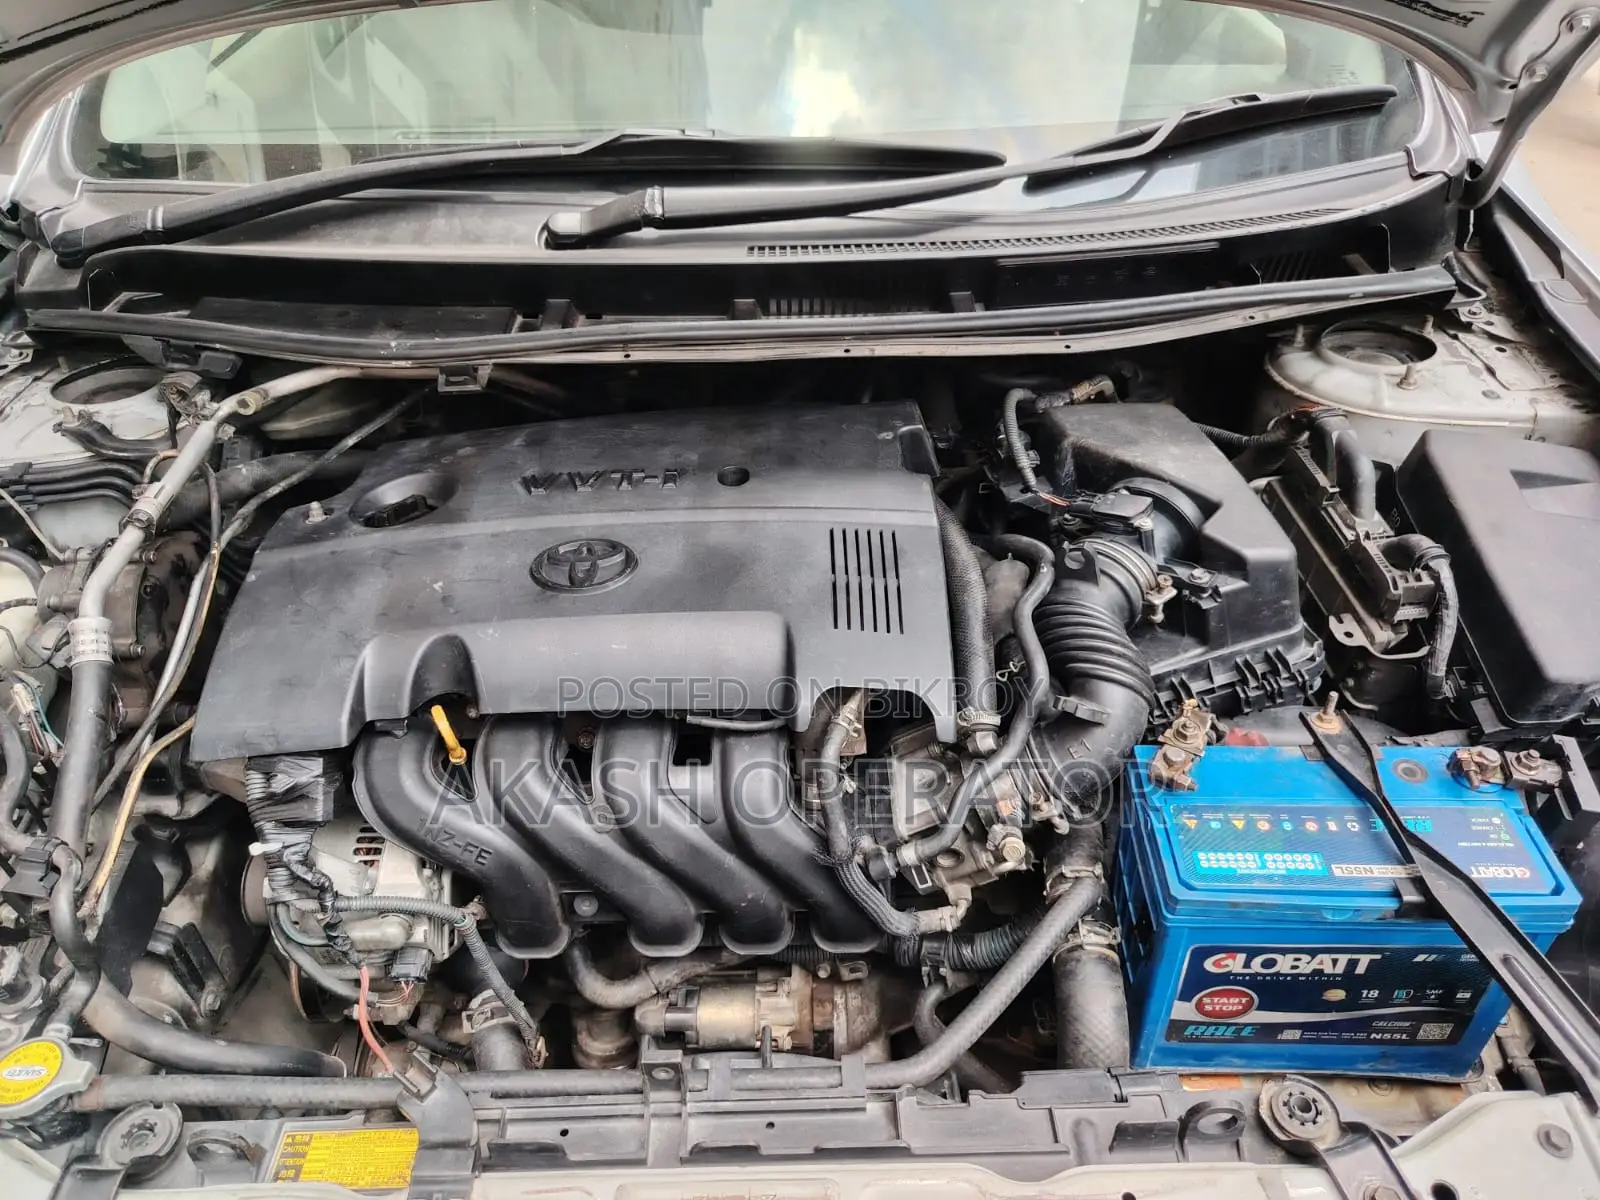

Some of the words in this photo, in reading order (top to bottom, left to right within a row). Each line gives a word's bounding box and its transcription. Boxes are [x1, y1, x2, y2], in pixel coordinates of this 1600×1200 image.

[1335, 865, 1374, 876] N55L
[1470, 866, 1530, 879] GLOBATT
[1203, 952, 1383, 975] GLOBATT
[1361, 989, 1379, 998] 18
[1184, 1025, 1260, 1036] RACE
